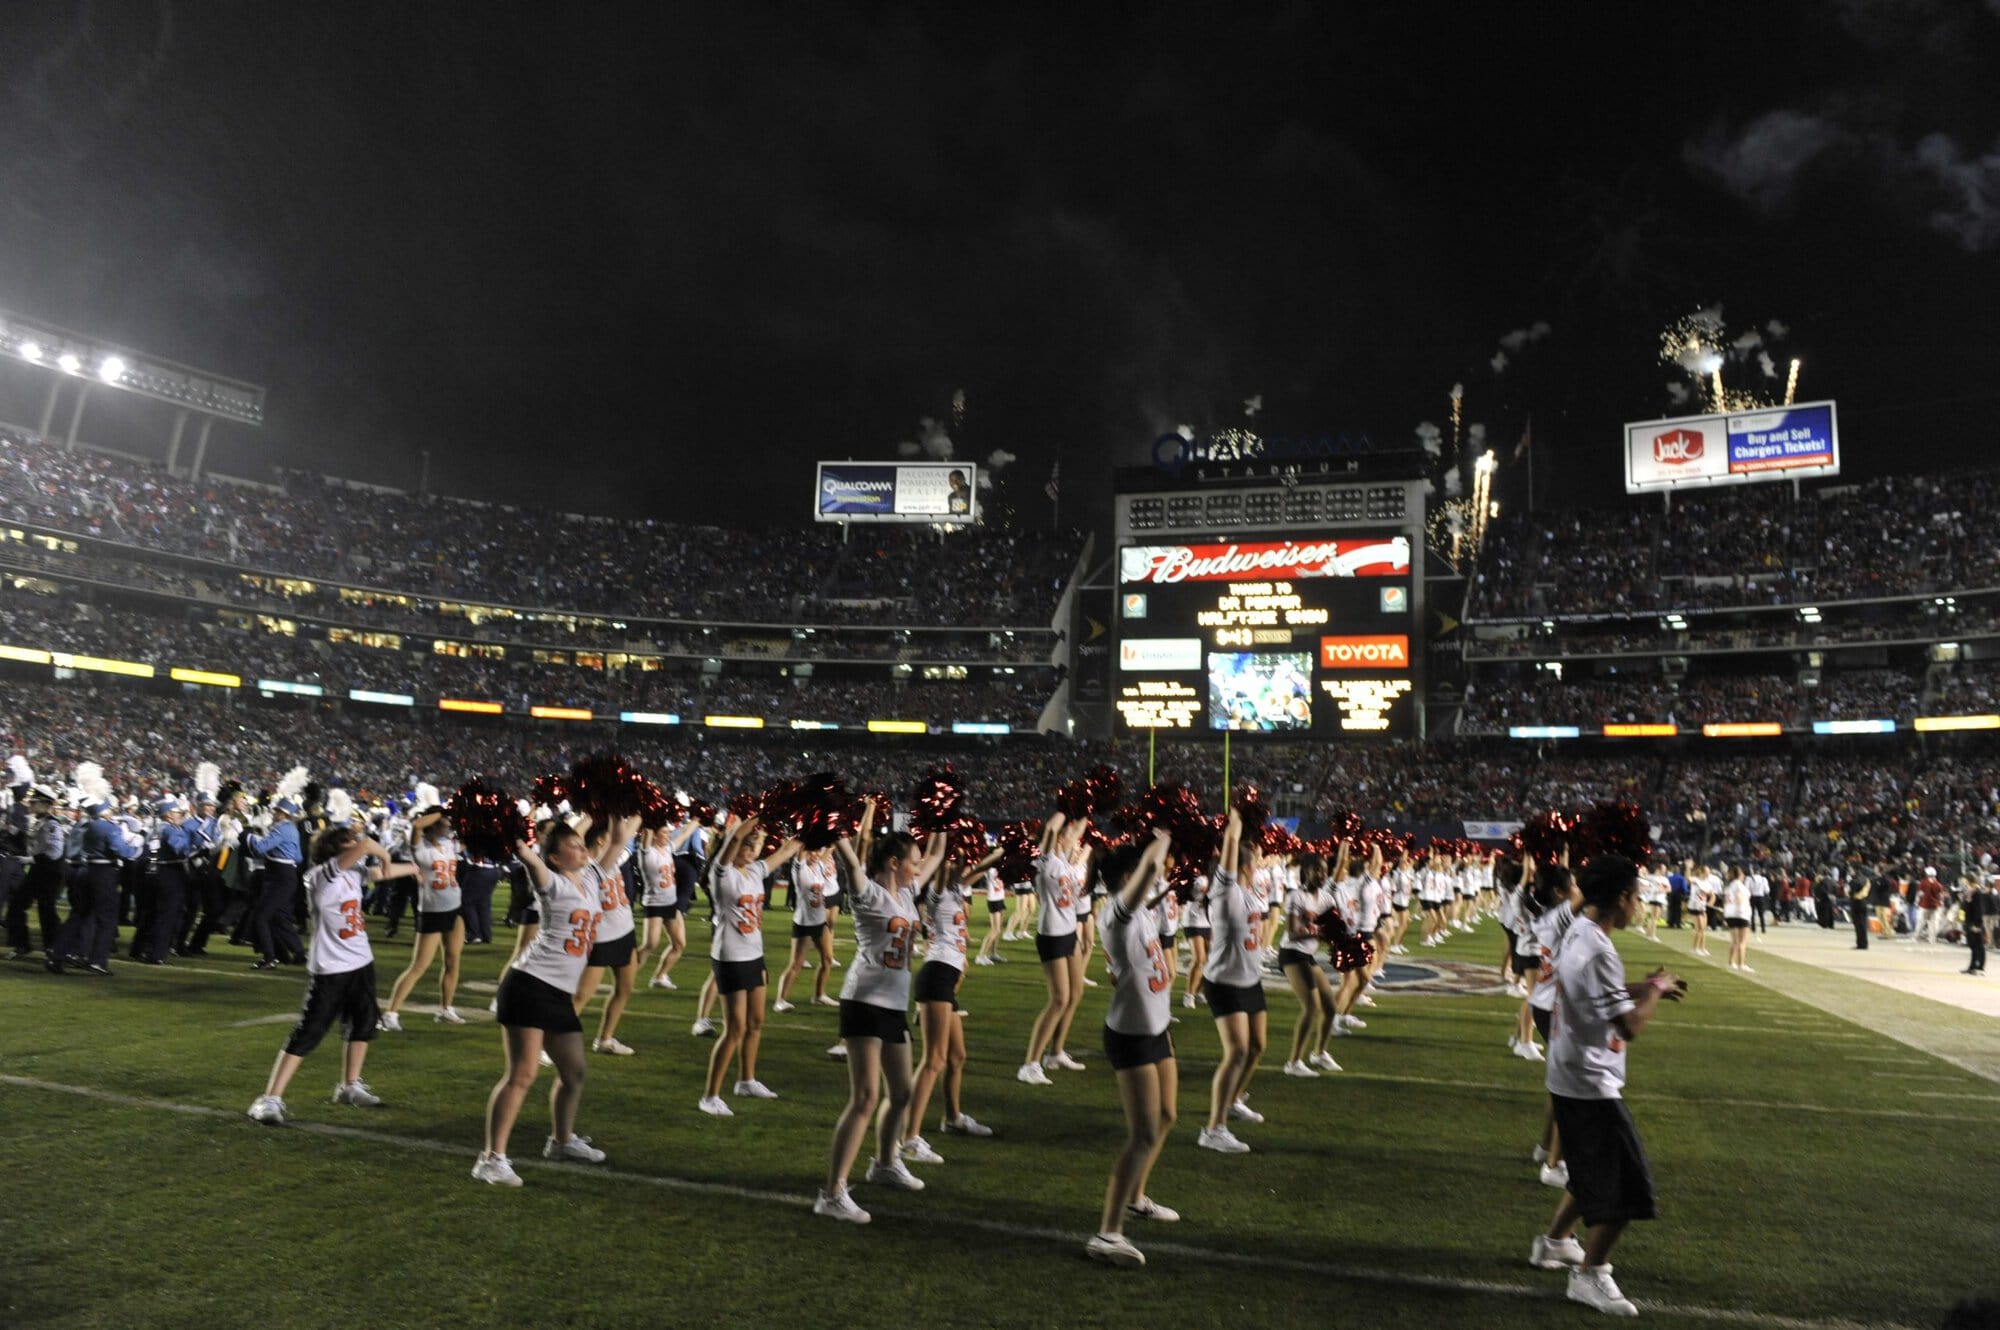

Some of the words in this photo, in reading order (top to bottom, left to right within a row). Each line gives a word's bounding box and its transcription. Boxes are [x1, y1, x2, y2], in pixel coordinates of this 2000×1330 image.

[1747, 433, 1767, 445] Buy
[1769, 430, 1789, 443] and
[1790, 427, 1811, 441] Sell
[1654, 432, 1692, 462] Jack
[1734, 445, 1783, 459] Chargers
[1784, 438, 1826, 454] Tickets!
[823, 479, 892, 495] QUALCOMM
[1151, 541, 1338, 583] Budweiser
[1325, 645, 1404, 661] TOYOTA
